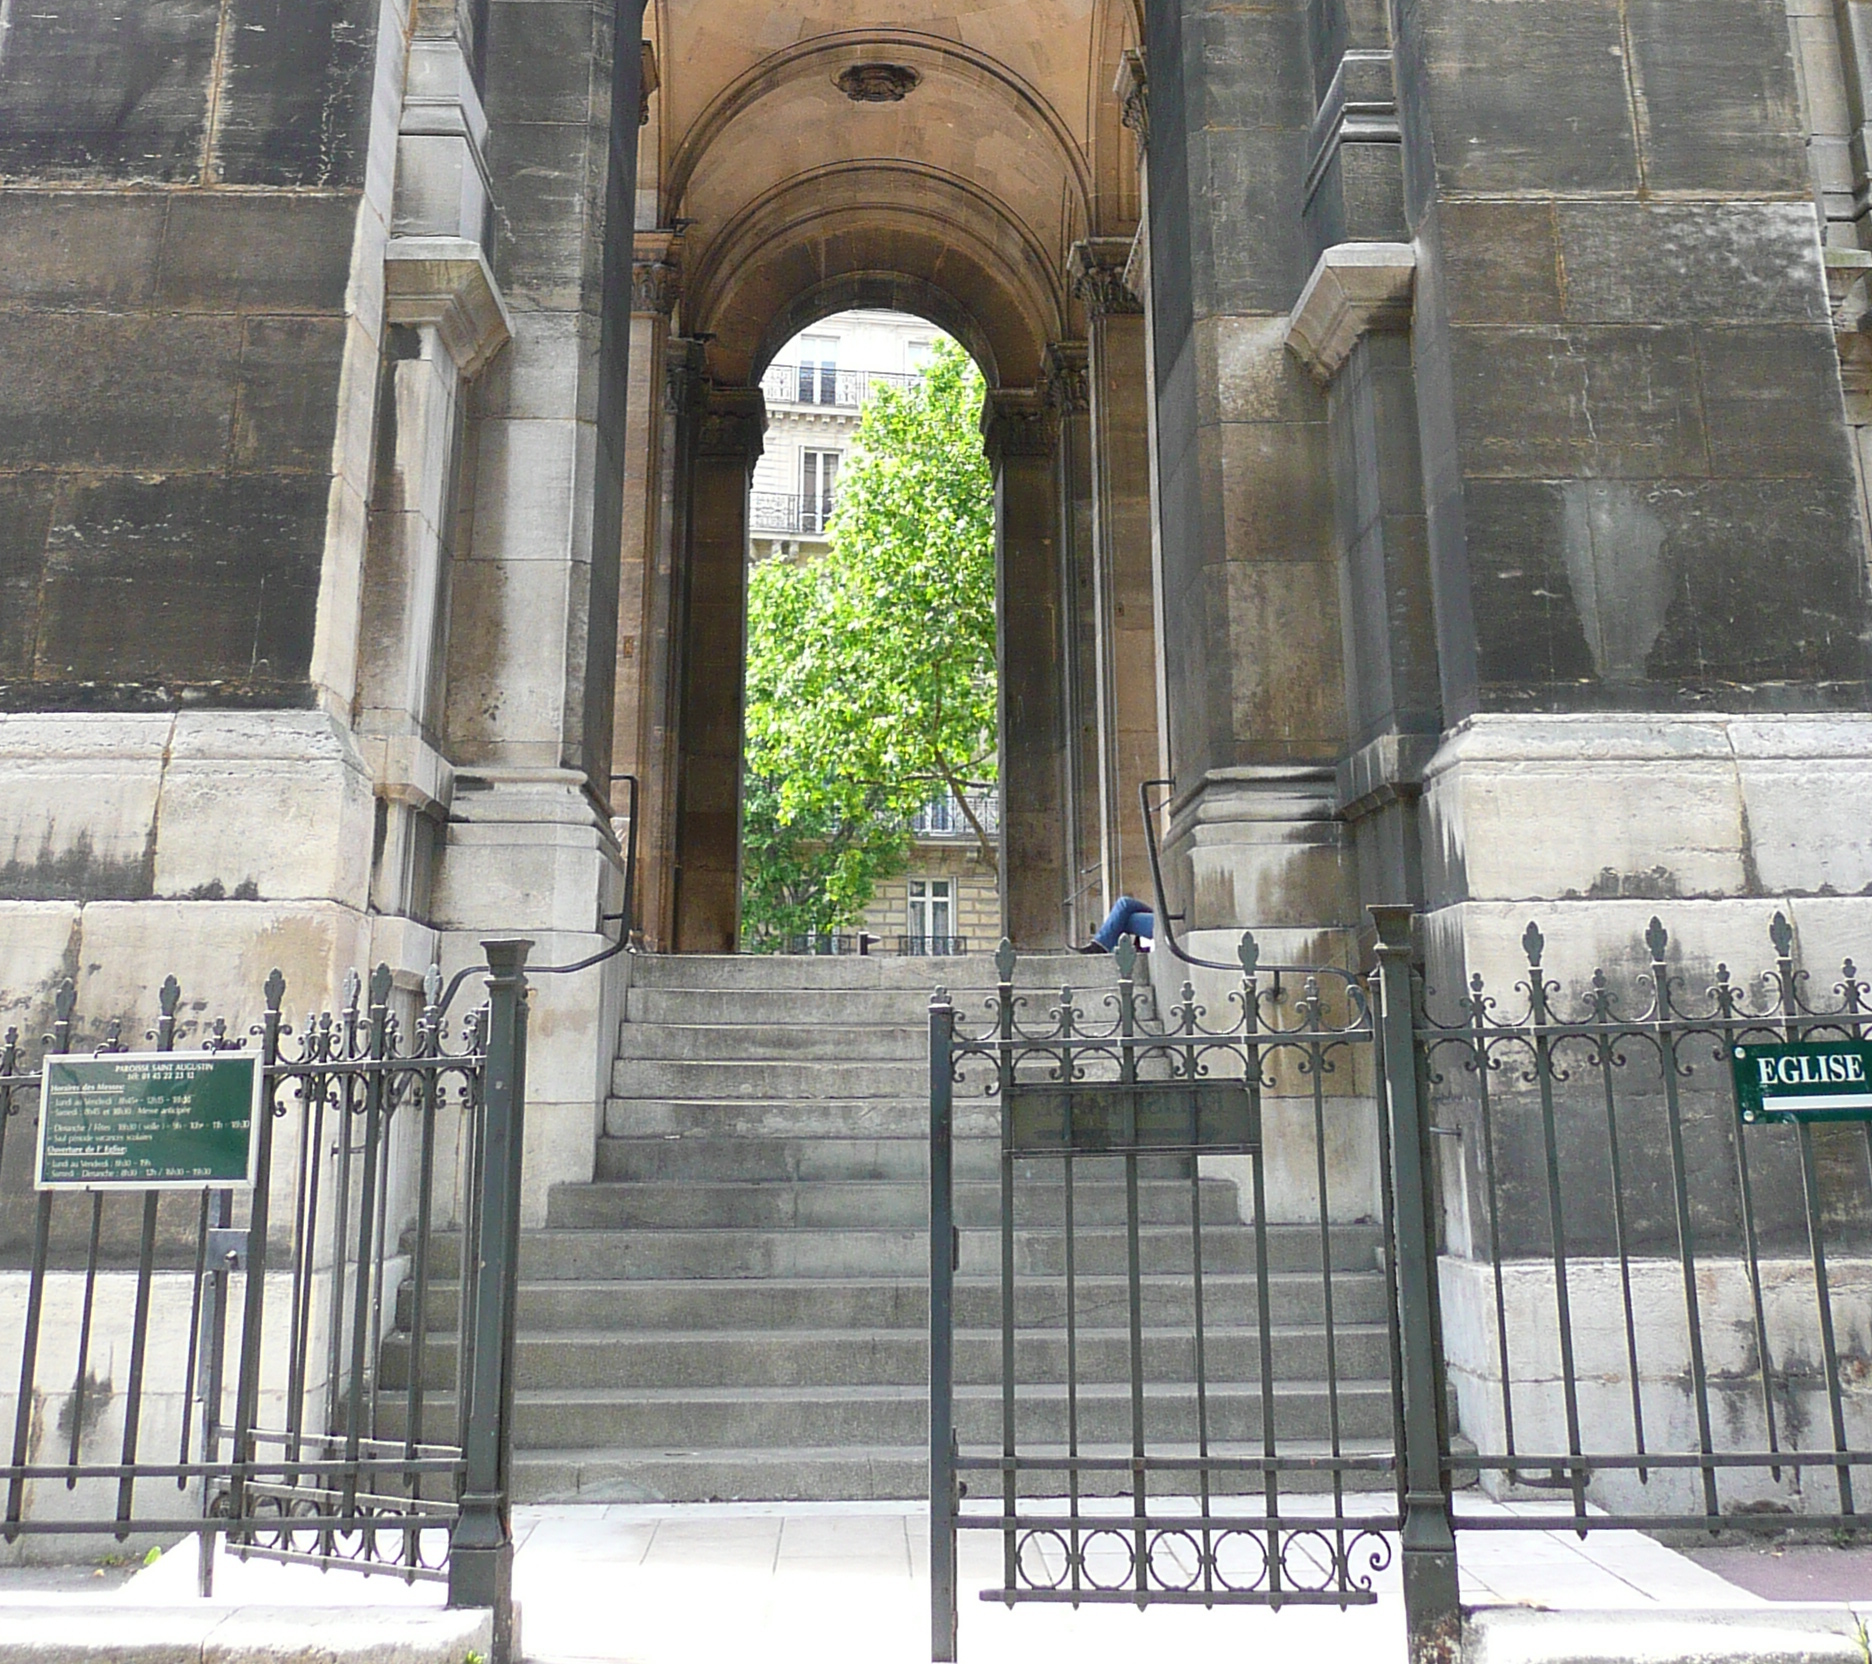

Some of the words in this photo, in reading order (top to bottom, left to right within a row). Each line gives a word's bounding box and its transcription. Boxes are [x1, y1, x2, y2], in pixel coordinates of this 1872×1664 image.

[115, 1064, 149, 1072] PAROISSE
[175, 1063, 213, 1071] AUGUSTIN
[1757, 1054, 1866, 1084] EGLISE
